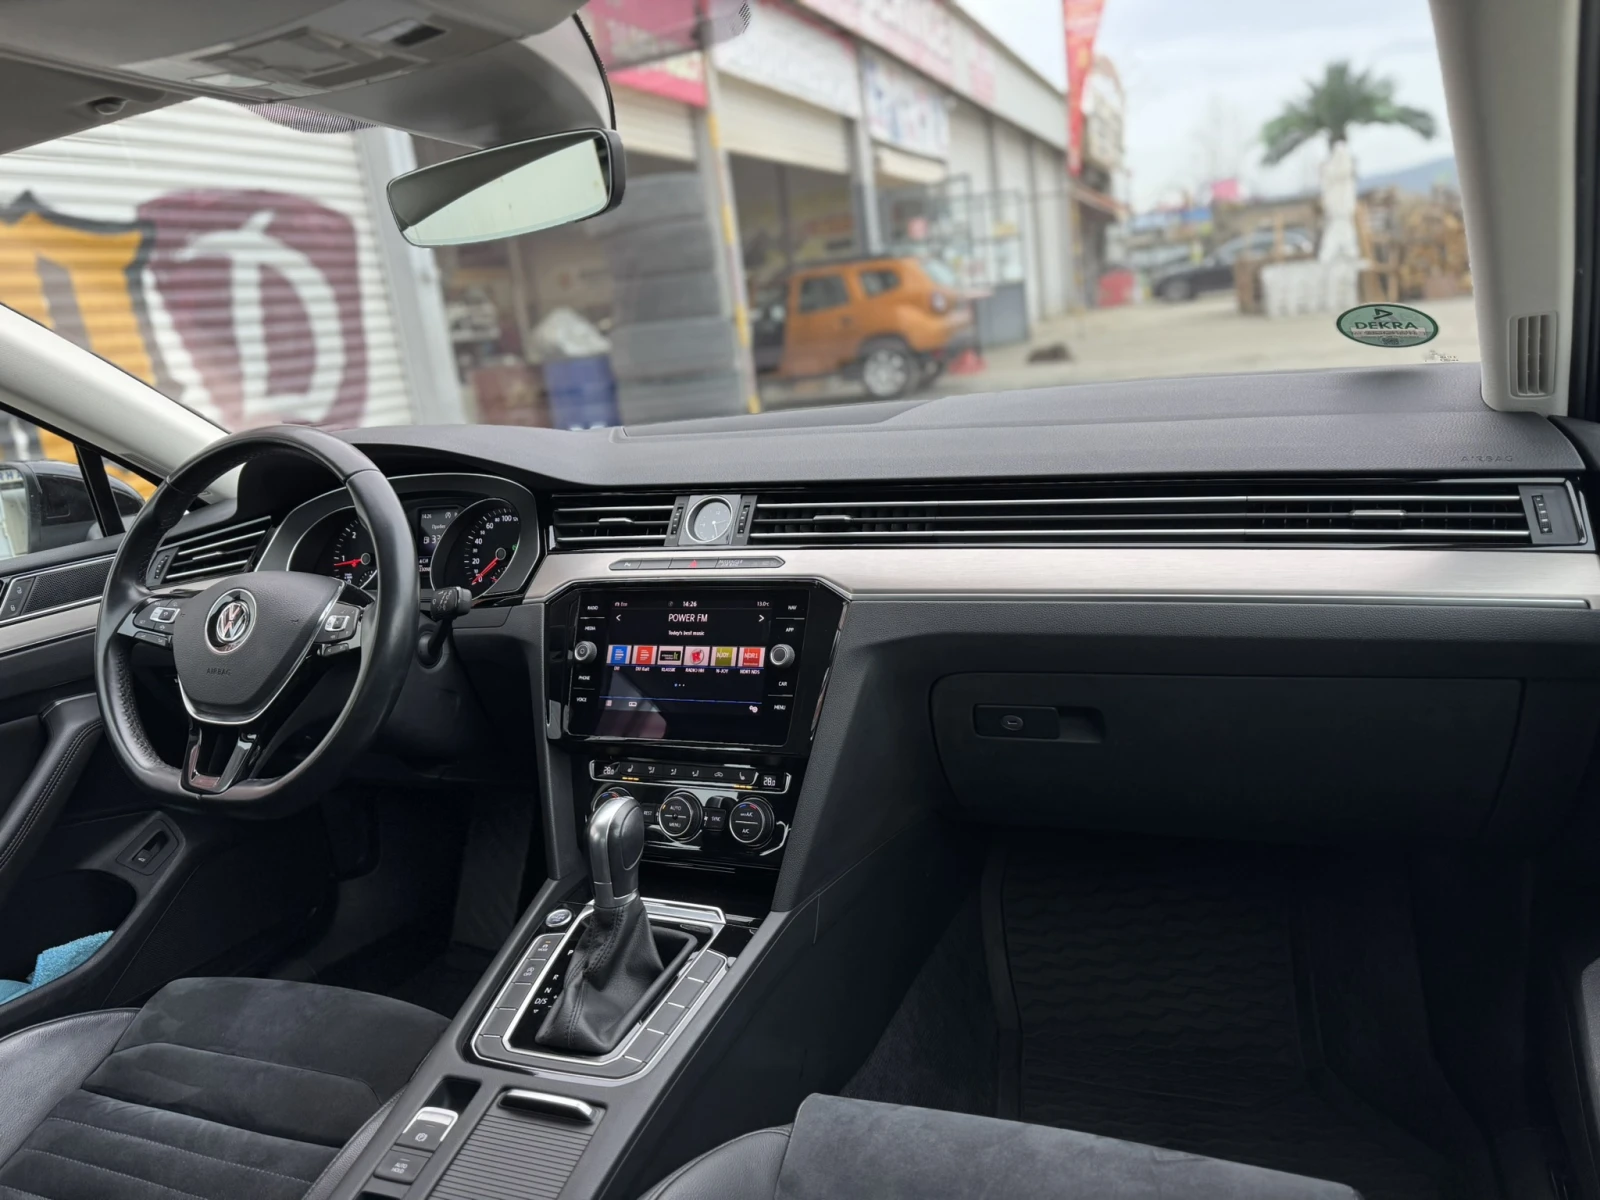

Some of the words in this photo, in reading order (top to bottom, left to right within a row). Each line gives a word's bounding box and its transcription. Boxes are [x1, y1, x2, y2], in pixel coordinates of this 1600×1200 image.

[1354, 321, 1418, 329] DEKRA
[351, 531, 357, 539] 2
[668, 613, 695, 622] POWER
[696, 613, 708, 622] FM
[206, 667, 233, 676] AIRBAG
[534, 997, 548, 1005] D/S
